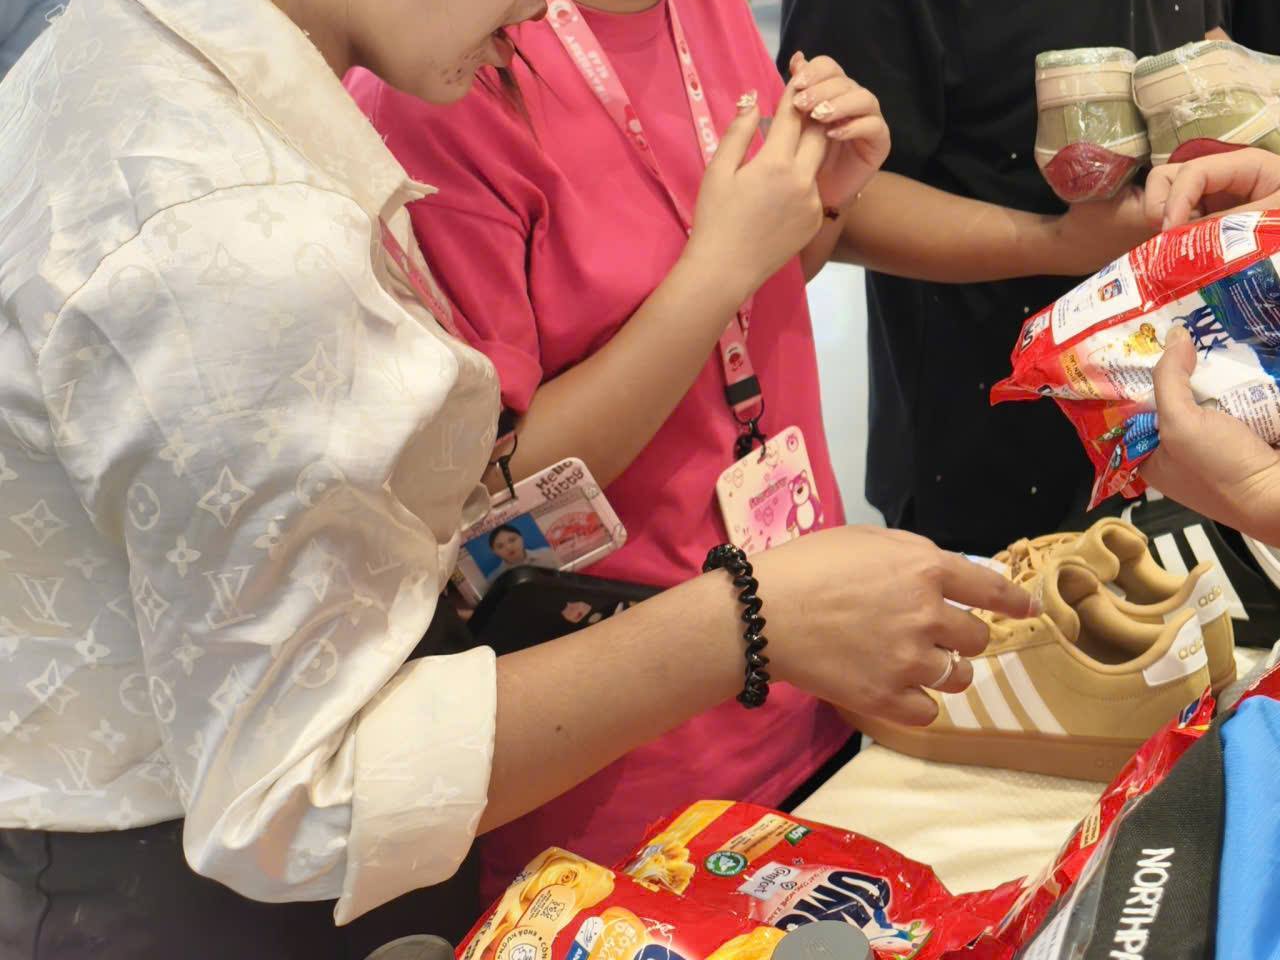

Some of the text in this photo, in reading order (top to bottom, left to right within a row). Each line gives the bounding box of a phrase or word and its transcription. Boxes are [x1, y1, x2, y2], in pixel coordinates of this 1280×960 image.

[536, 461, 573, 489] Hello
[542, 470, 584, 500] Kitty
[754, 866, 791, 893] Comfort
